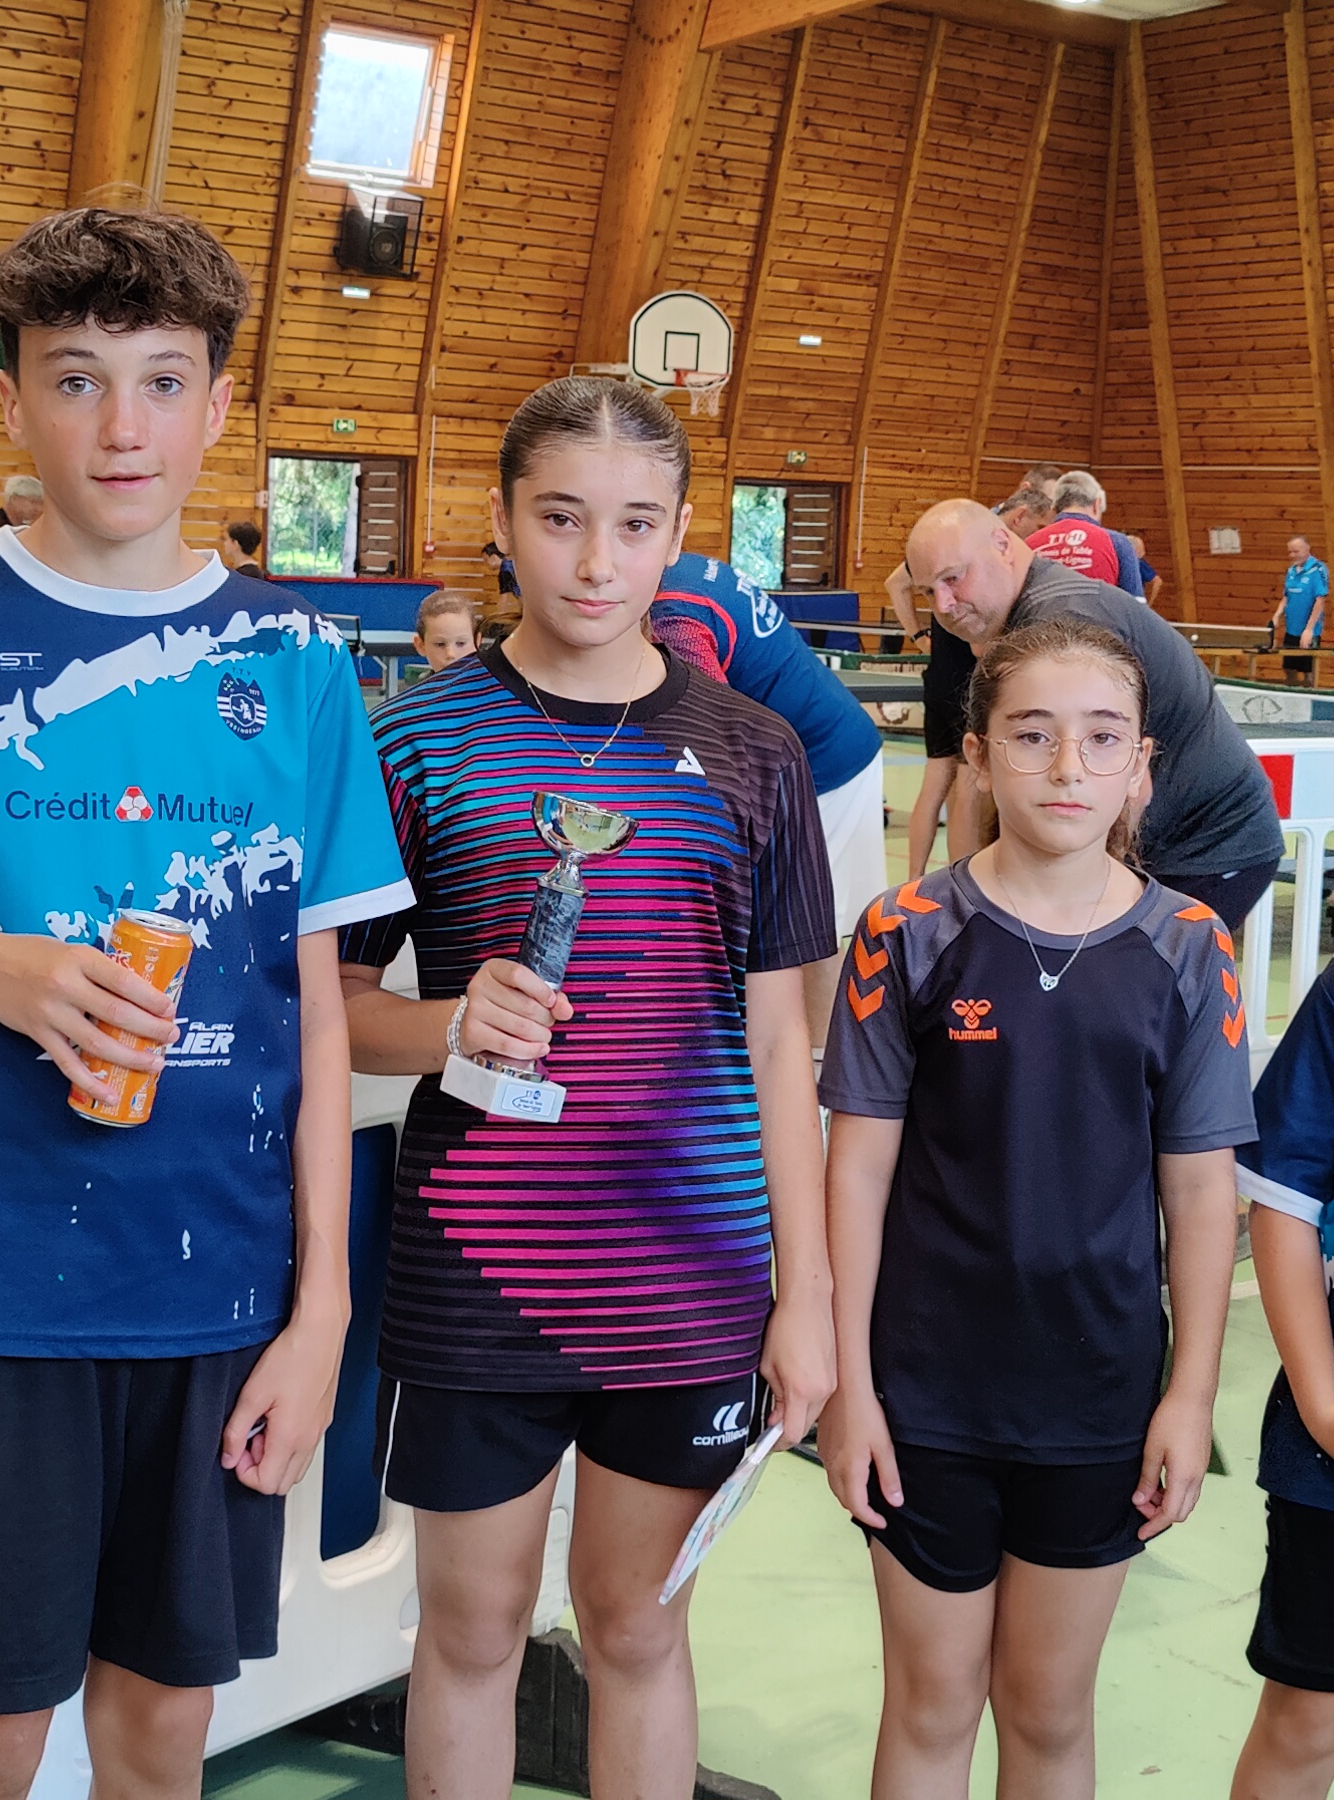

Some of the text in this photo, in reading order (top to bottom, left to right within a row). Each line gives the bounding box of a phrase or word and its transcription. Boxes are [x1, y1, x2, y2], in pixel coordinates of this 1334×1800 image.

[0, 652, 43, 666] ST
[5, 790, 254, 827] Crédit Mutuel
[189, 1021, 234, 1031] ALAIN
[948, 1027, 997, 1041] hummel
